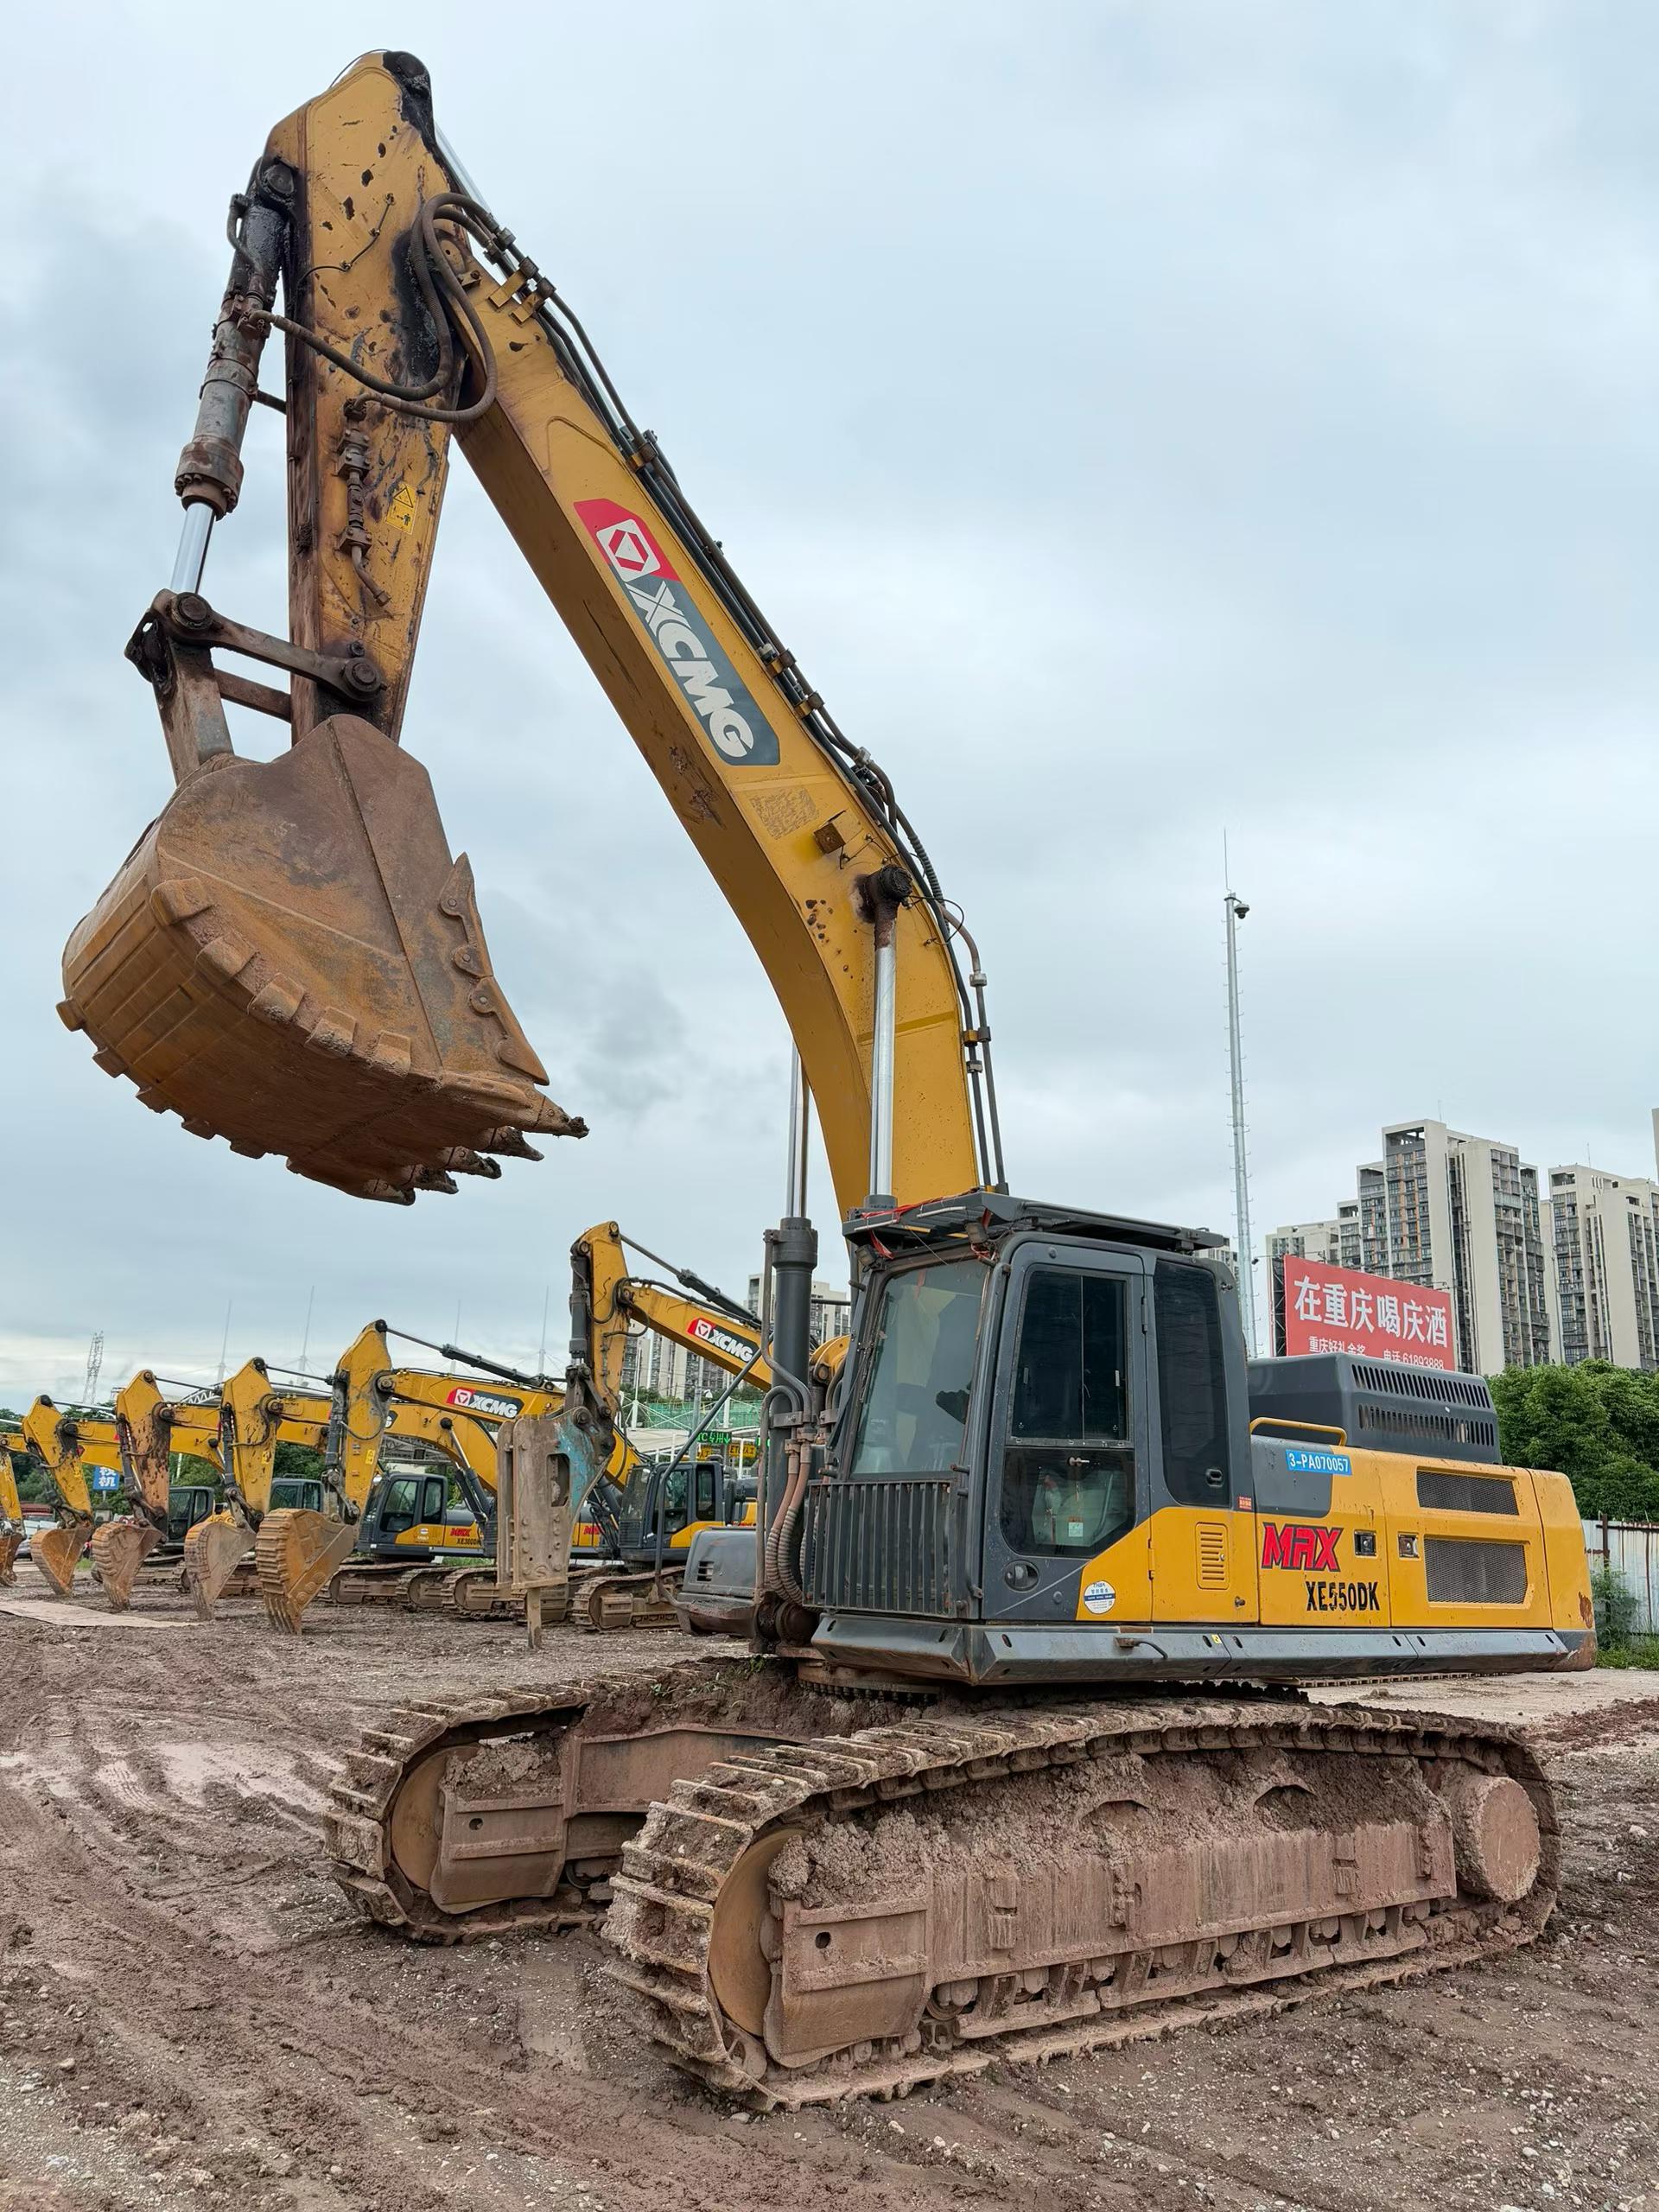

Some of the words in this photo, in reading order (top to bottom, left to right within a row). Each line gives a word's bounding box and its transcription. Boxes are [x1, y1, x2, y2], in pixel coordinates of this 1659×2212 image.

[625, 580, 754, 758] XCMG
[1294, 1274, 1448, 1349] 在重庆喝庆酒
[709, 1328, 753, 1362] XCMG
[468, 1394, 518, 1418] XCMG
[1288, 1452, 1350, 1473] 3-PA070057
[1305, 1580, 1380, 1611] XE550DK
